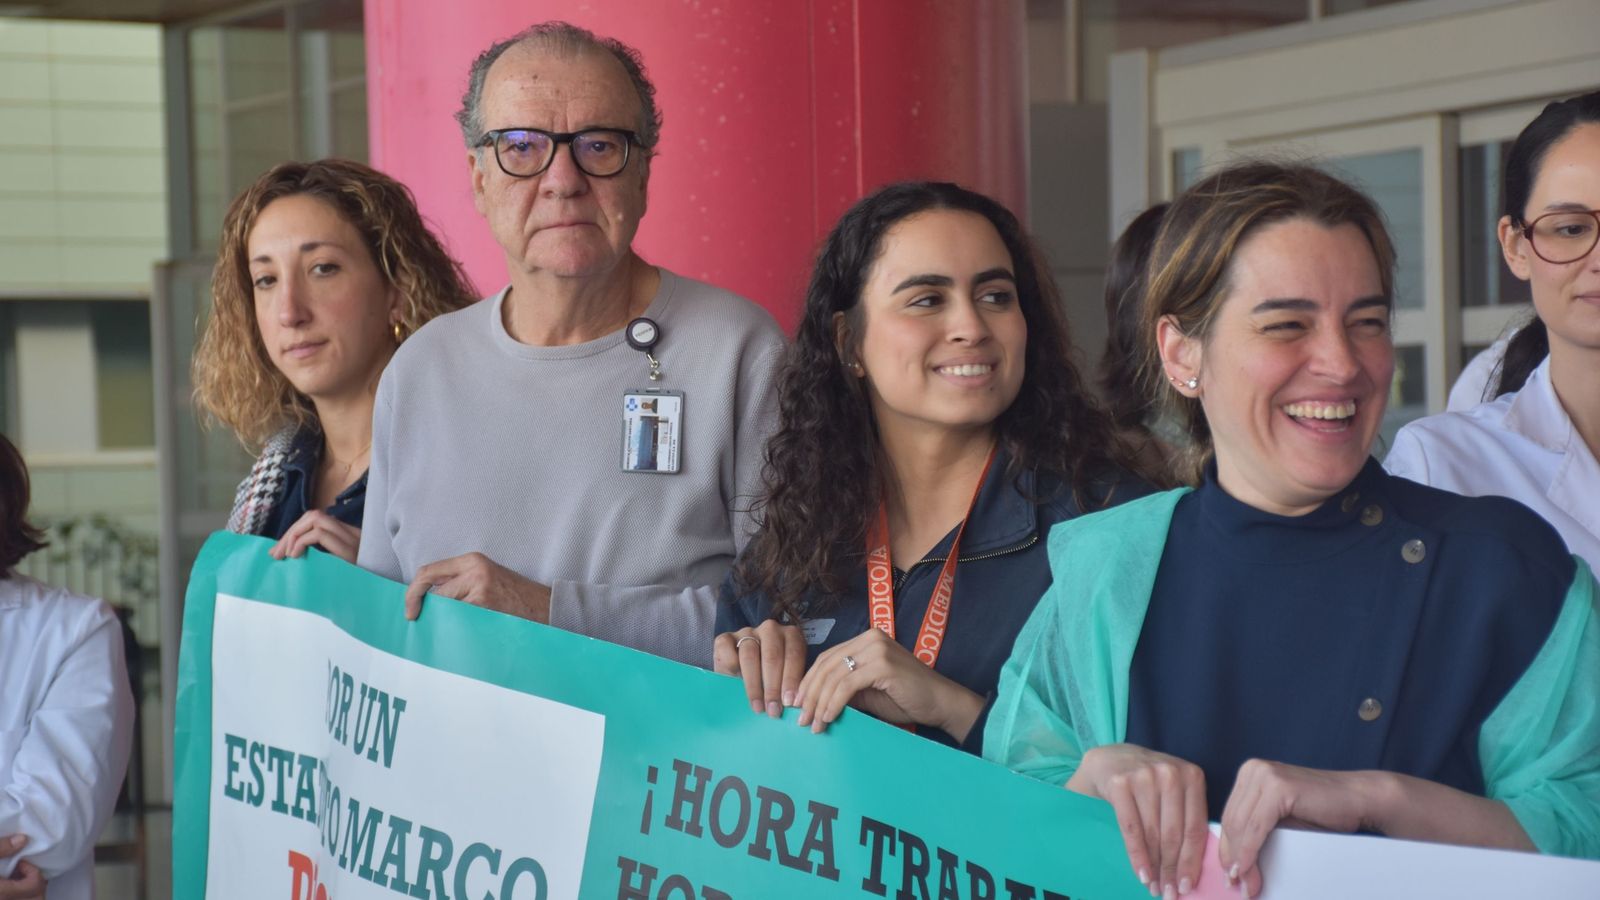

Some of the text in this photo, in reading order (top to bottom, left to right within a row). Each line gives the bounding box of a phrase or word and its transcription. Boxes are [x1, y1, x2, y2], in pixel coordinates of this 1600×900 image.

[870, 545, 892, 638] EDICO/A
[325, 658, 407, 769] OR UN
[339, 797, 548, 899] MARCO
[640, 758, 840, 882] ¡HORA
